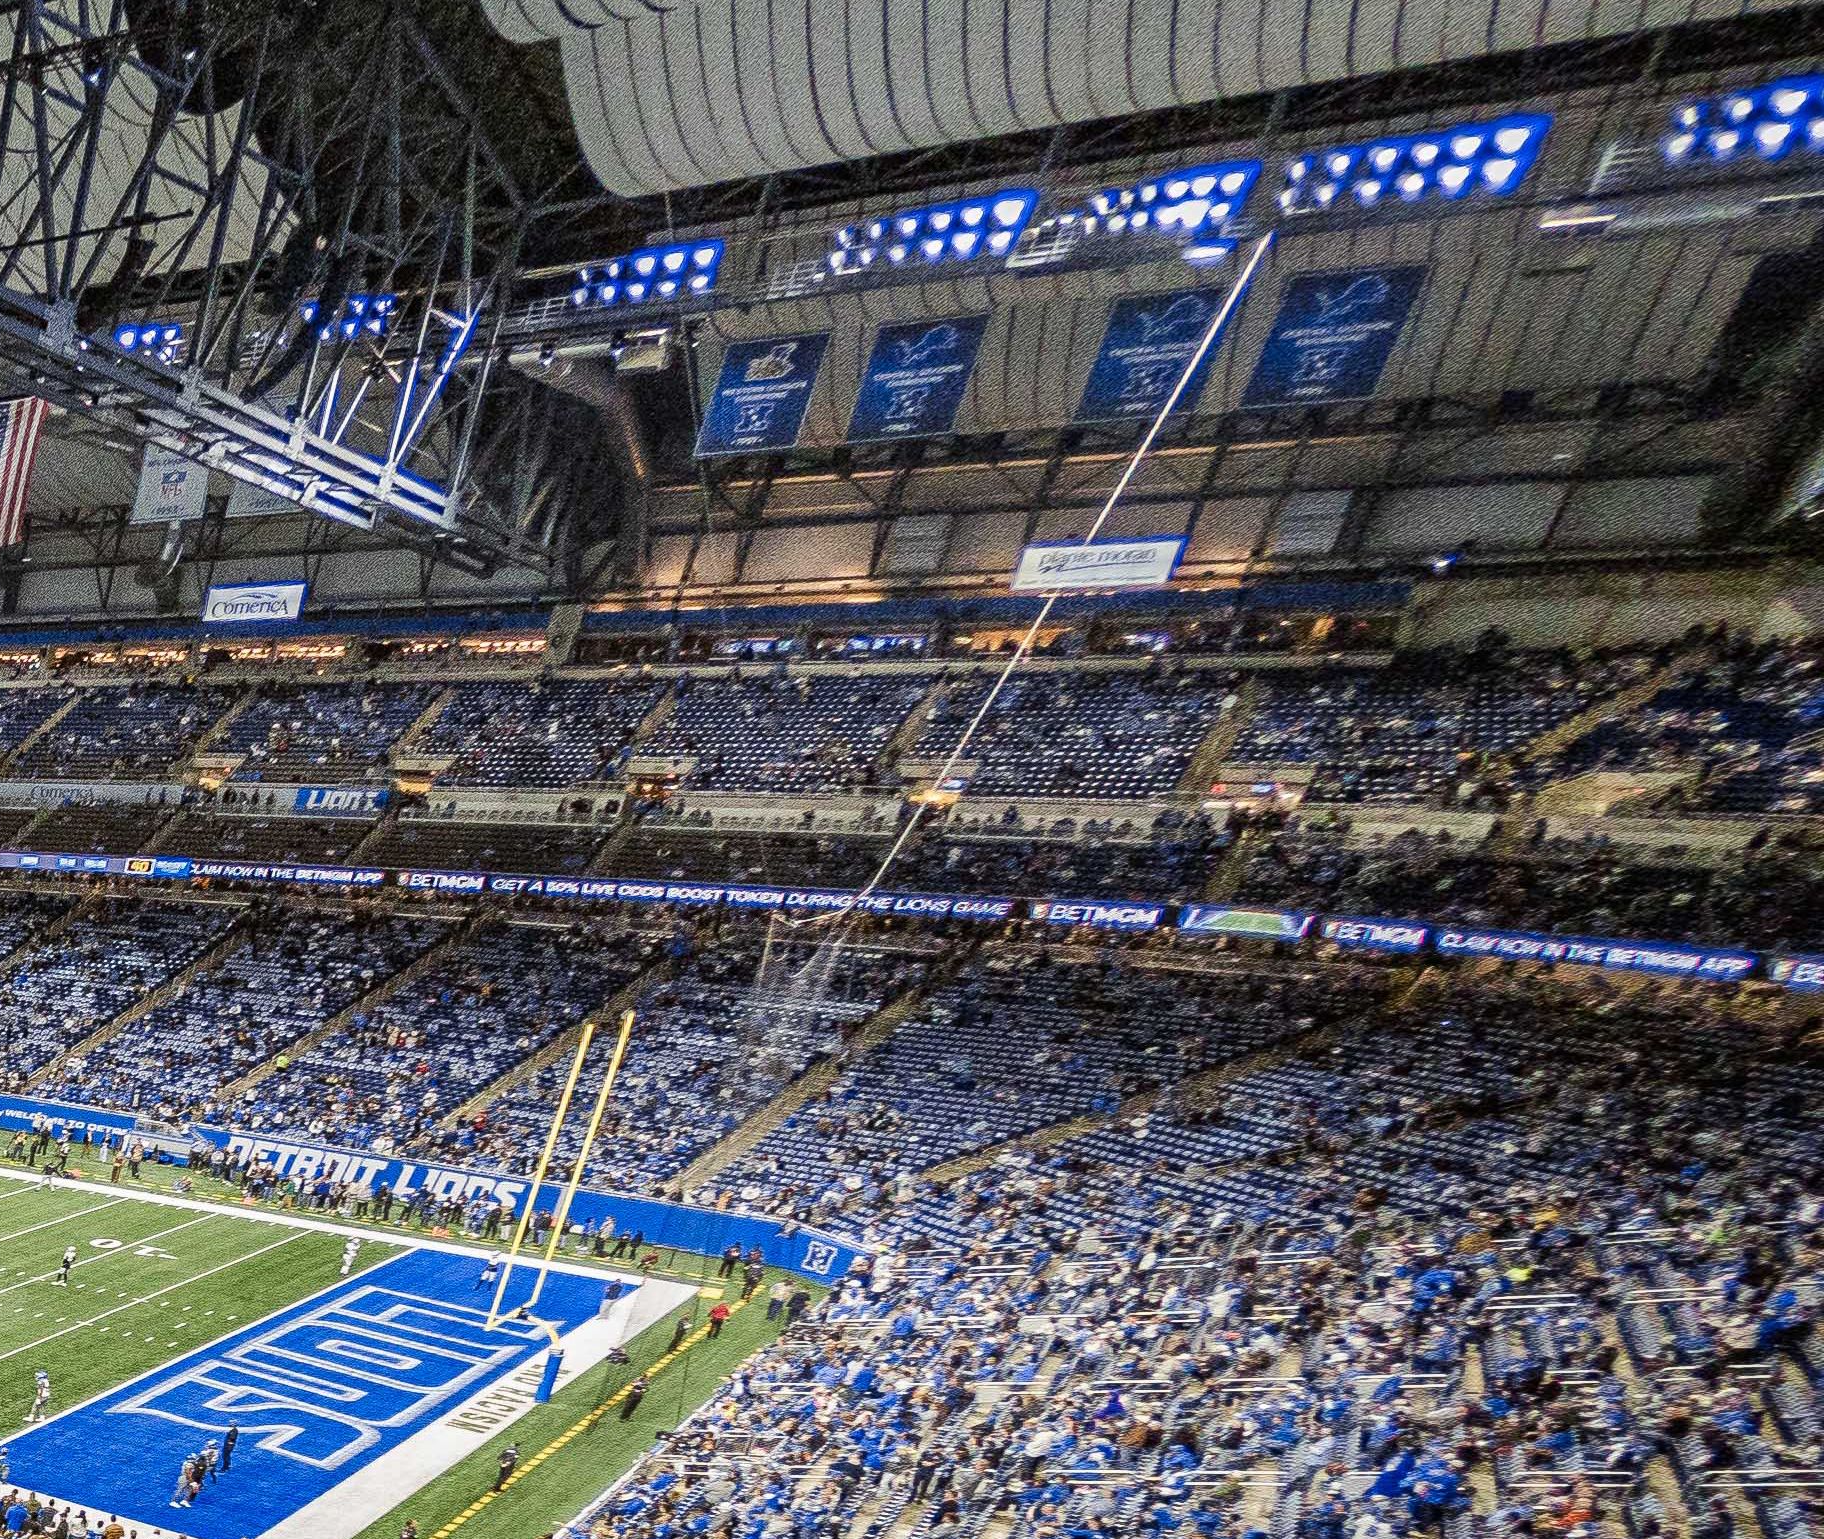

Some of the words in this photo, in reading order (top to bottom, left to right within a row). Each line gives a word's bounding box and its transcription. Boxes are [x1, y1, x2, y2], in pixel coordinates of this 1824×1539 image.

[223, 865, 254, 879] NOW
[254, 868, 268, 879] IN
[269, 868, 294, 880] THE
[354, 871, 384, 883] APP
[410, 872, 485, 890] BETMGM
[492, 878, 525, 892] GET
[527, 879, 544, 892] A
[581, 882, 616, 896] LIVE
[664, 885, 725, 901] BOOST
[726, 889, 785, 905] TOKEN
[786, 890, 854, 910] DURING
[856, 896, 892, 911] THE
[893, 897, 951, 914] LIONS
[953, 900, 1013, 916] GAME
[1050, 903, 1158, 924] BETMGM
[1337, 921, 1426, 945] BETMGM
[1439, 931, 1499, 951] CLAIM
[1500, 937, 1541, 954] NOW
[1699, 953, 1752, 973] APP
[224, 1135, 390, 1188] DETROIT
[392, 1161, 528, 1209] LIONS
[105, 1284, 567, 1471] LIONS
